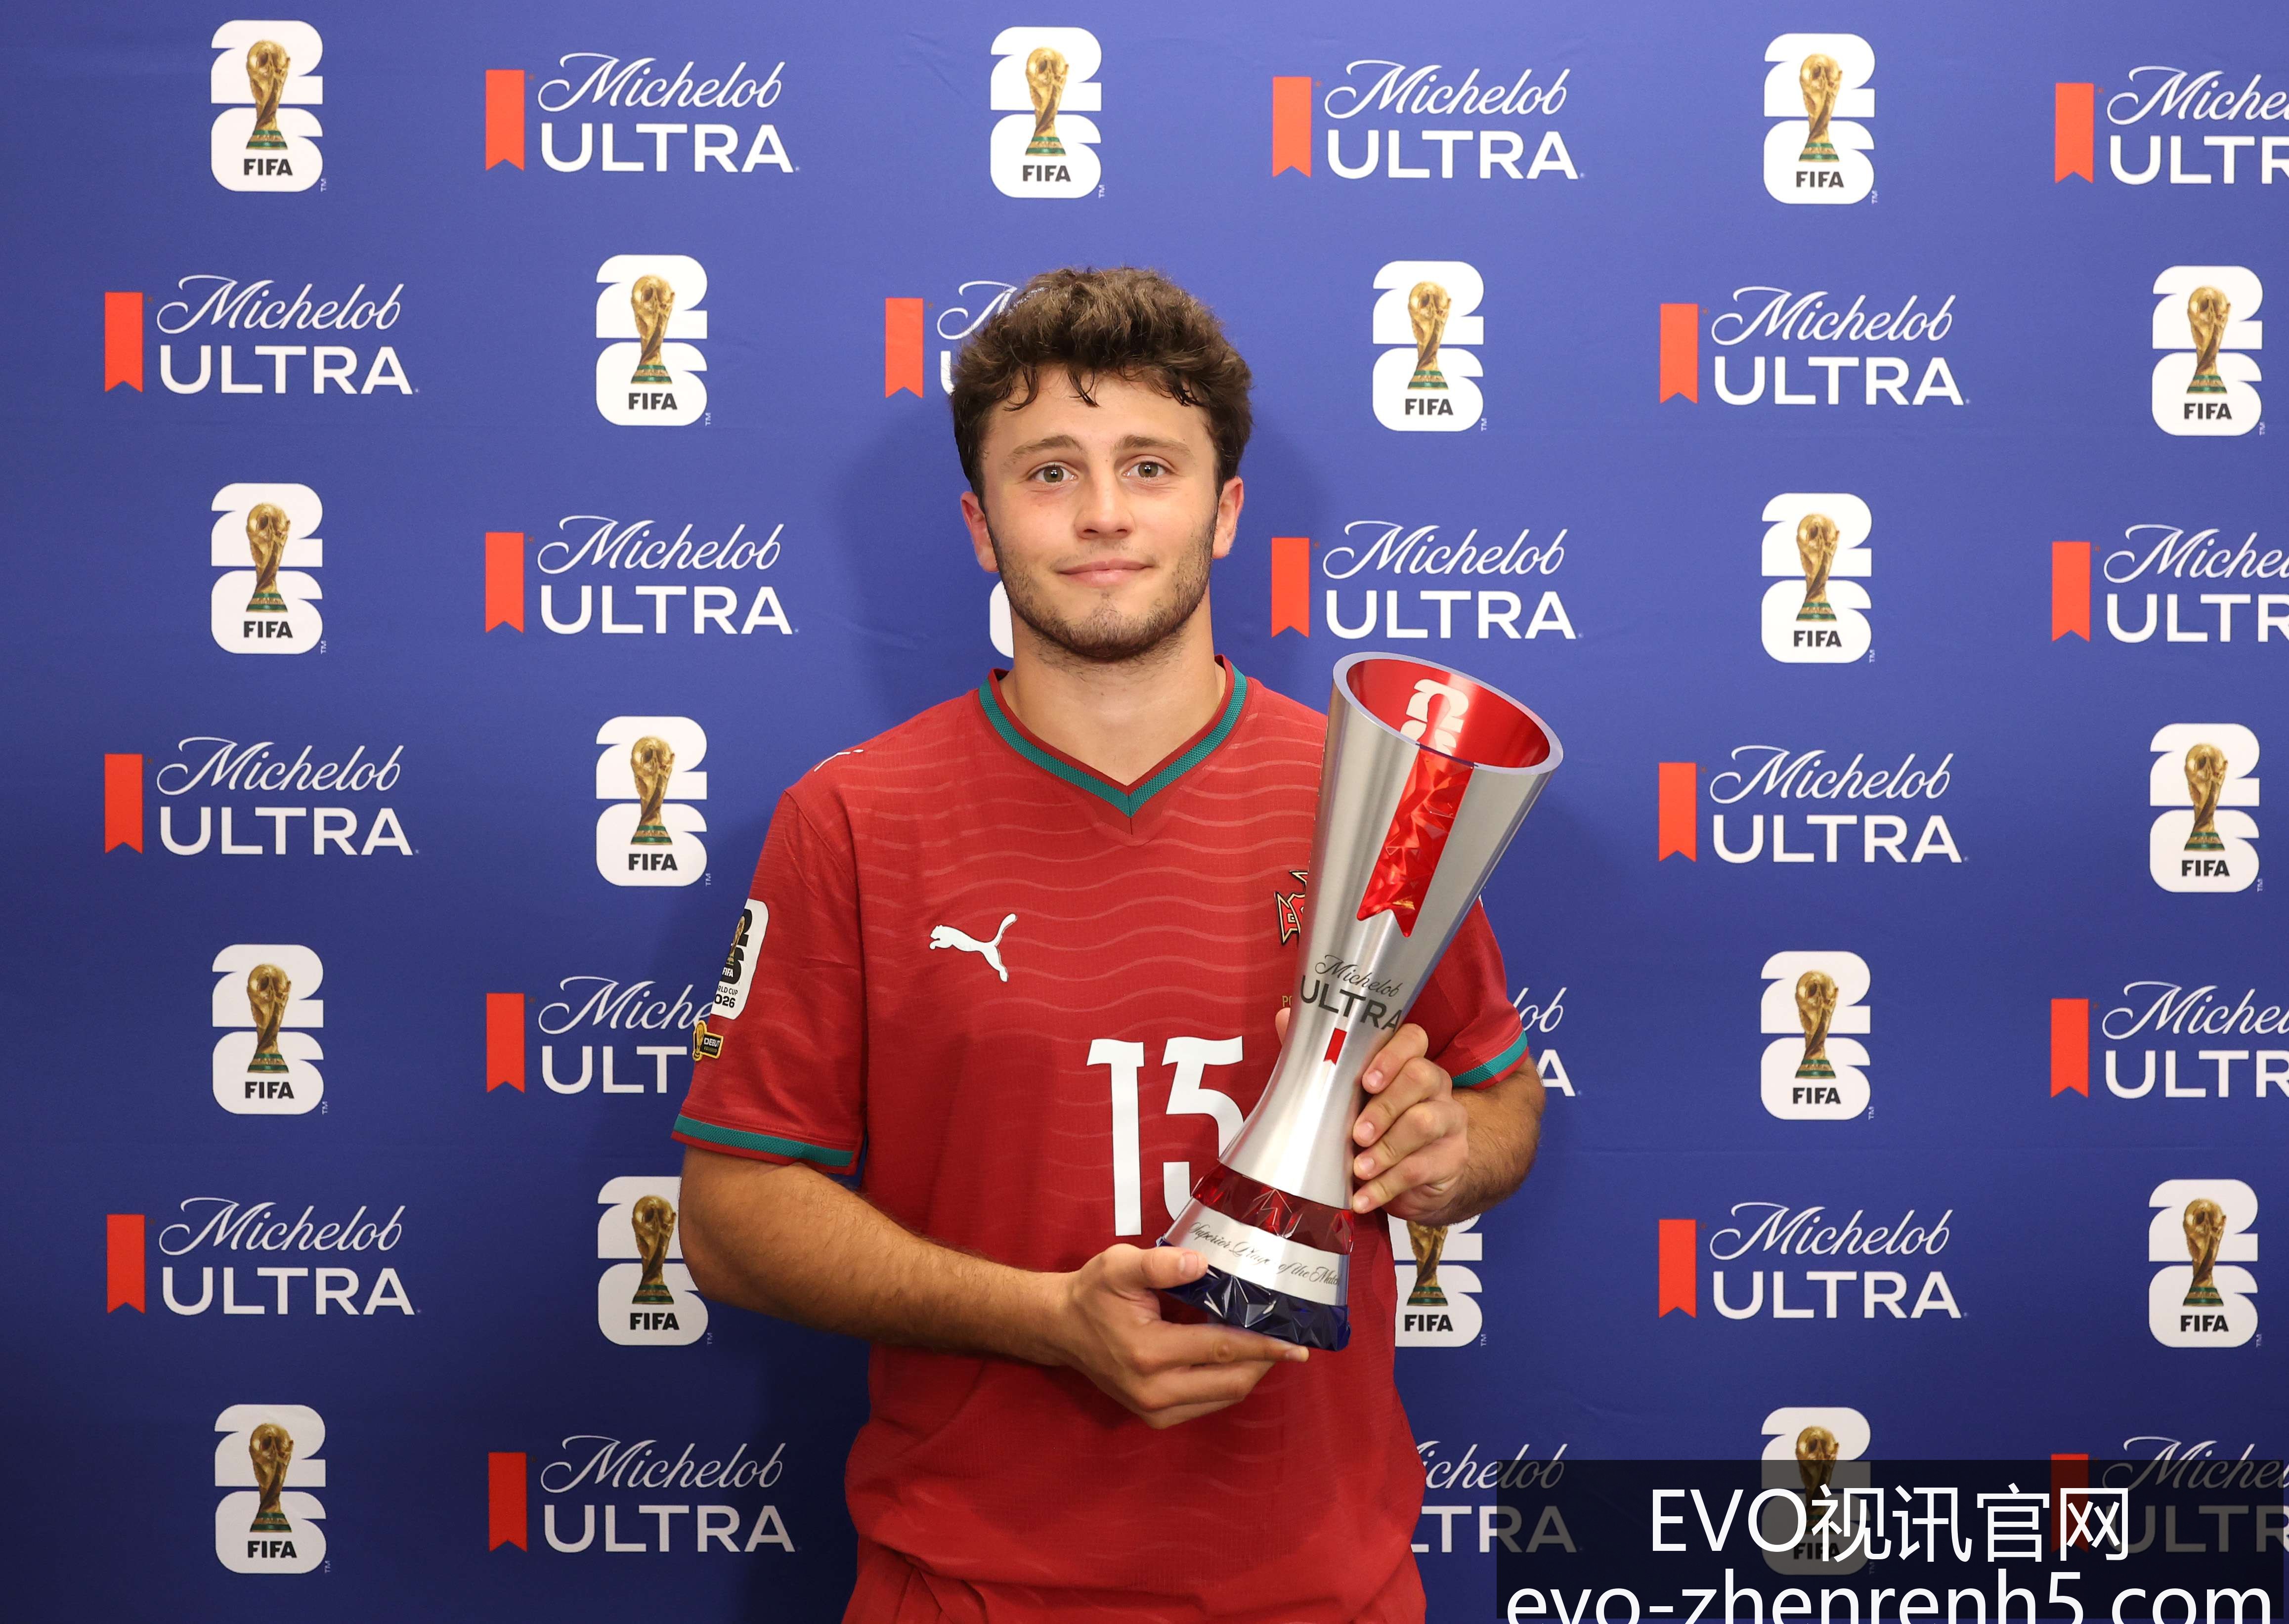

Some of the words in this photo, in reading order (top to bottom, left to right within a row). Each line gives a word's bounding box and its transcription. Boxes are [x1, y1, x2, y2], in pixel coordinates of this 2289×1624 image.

[538, 52, 785, 112] Michelob
[1324, 59, 1571, 119] Michelob
[2107, 66, 2289, 125] Miche
[244, 159, 293, 175] FIFA
[541, 122, 794, 173] ULTRA
[1327, 128, 1579, 179] ULTRA
[1023, 166, 1071, 181] FIFA
[1797, 171, 1844, 187] FIFA
[157, 275, 404, 334] Michelob
[1711, 286, 1956, 345] Michelob
[161, 345, 413, 394] ULTRA
[1714, 356, 1964, 405] ULTRA
[629, 393, 677, 409] FIFA
[1406, 399, 1453, 415] FIFA
[2185, 403, 2232, 419] FIFA
[538, 515, 784, 574] Michelob
[1323, 520, 1568, 579] Michelob
[2104, 524, 2289, 583] Miche
[244, 621, 293, 638] FIFA
[541, 585, 792, 635] ULTRA
[1326, 590, 1576, 640] ULTRA
[1794, 631, 1841, 646] FIFA
[157, 737, 404, 795] Michelob
[1710, 745, 1953, 804] Michelob
[161, 807, 413, 855] ULTRA
[1713, 814, 1962, 863] ULTRA
[629, 854, 677, 870] FIFA
[2182, 860, 2229, 876] FIFA
[1315, 954, 1403, 997] Michelob
[1300, 975, 1402, 1033] ULTRA
[2102, 981, 2289, 1039] Miche
[703, 1037, 720, 1047] DEBUT
[245, 1082, 294, 1098] FIFA
[1793, 1088, 1841, 1104] FIFA
[1087, 1036, 1244, 1237] 15
[159, 1197, 405, 1255] Michelob
[1189, 1221, 1231, 1249] Superior
[1710, 1202, 1952, 1260] Michelob
[163, 1267, 414, 1315] ULTRA
[1714, 1271, 1961, 1320] ULTRA
[630, 1313, 679, 1330] FIFA
[1405, 1315, 1453, 1331] FIFA
[2181, 1316, 2228, 1331] FIFA
[541, 1435, 782, 1494] Michelob
[248, 1541, 297, 1558] FIFA
[545, 1505, 795, 1552] ULTRA
